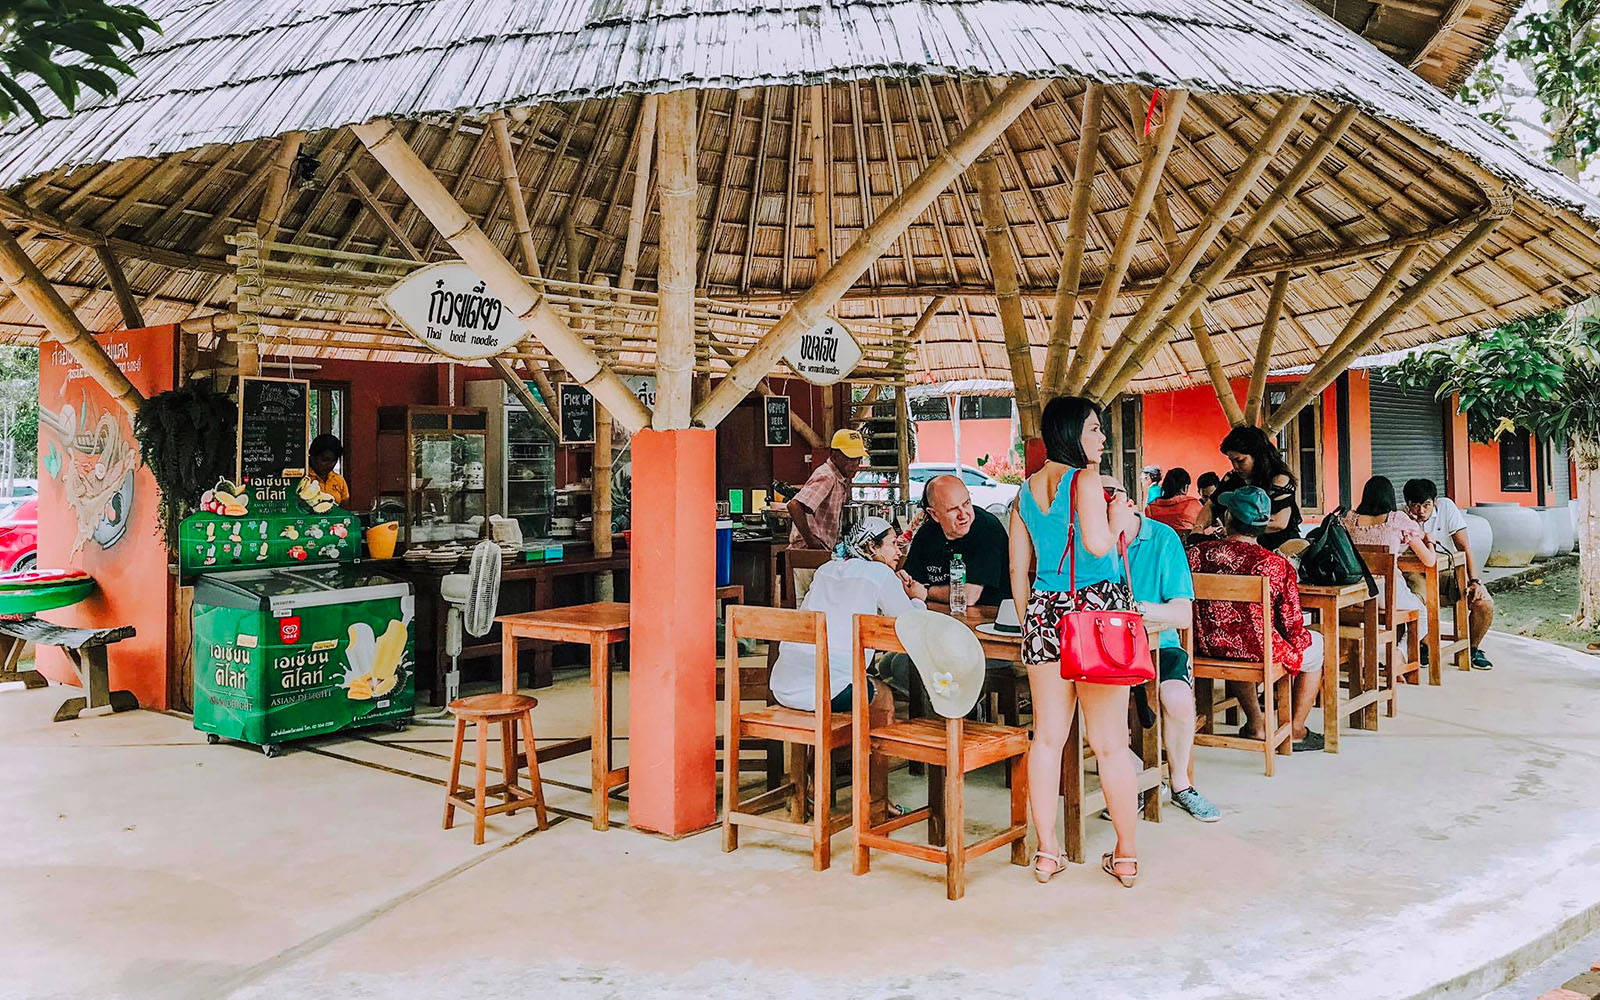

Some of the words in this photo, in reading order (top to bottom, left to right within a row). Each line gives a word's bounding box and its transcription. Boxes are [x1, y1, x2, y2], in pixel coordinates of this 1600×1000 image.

[426, 326, 442, 340] Thai
[450, 329, 467, 343] boat
[471, 334, 499, 347] noodles
[563, 393, 580, 406] PICK
[582, 393, 592, 405] UP
[210, 640, 251, 665] เอเชียน
[274, 650, 329, 670] เอเชียน
[215, 662, 246, 690] ดิไลท์
[281, 665, 323, 689] ดิไลท์
[271, 695, 297, 707] ASIAN
[297, 689, 333, 703] DELIGHT
